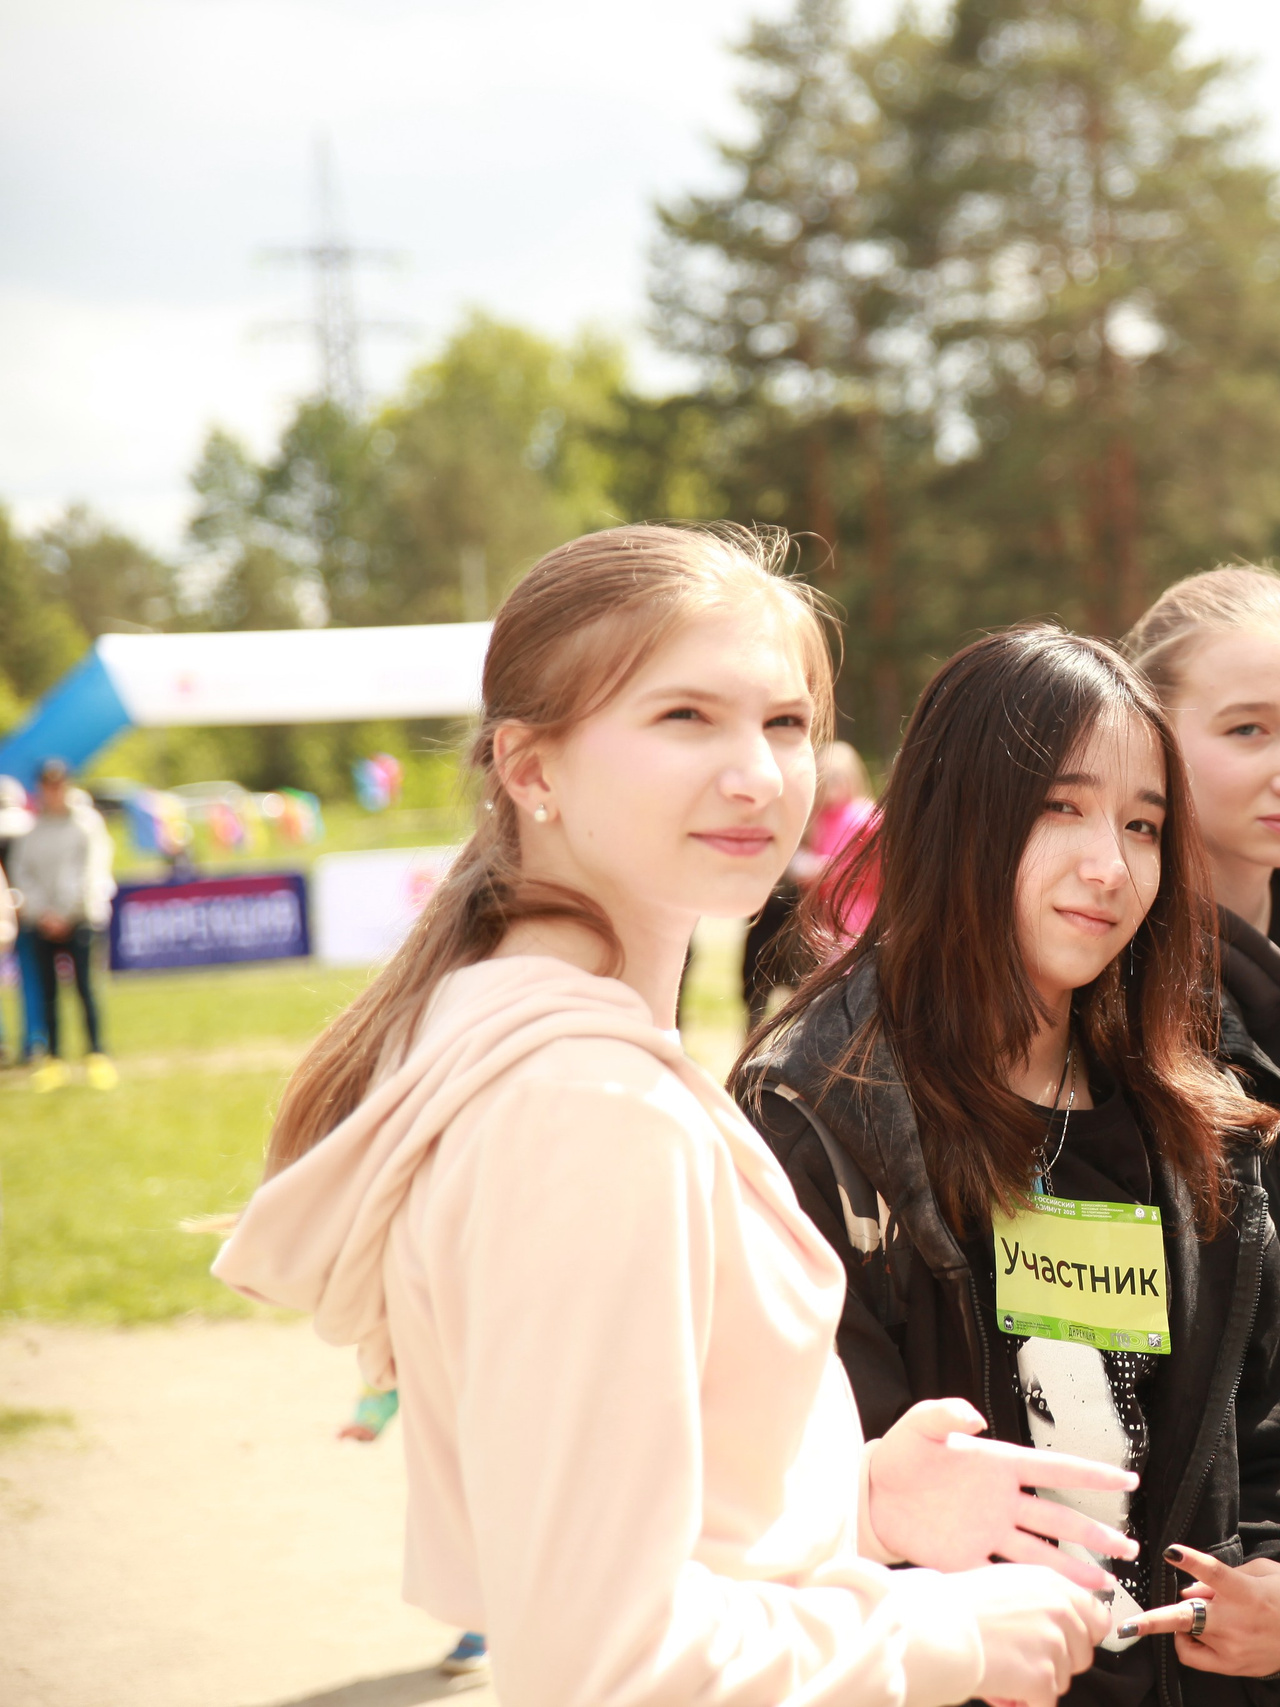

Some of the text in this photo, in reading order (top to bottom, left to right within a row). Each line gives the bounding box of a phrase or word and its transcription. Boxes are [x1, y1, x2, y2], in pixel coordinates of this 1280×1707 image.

[1034, 1195, 1076, 1209] РОССИЙСКИЙ
[1000, 1237, 1160, 1297] Участник
[1068, 1327, 1096, 1341] ДИРЕКЦИЯ
